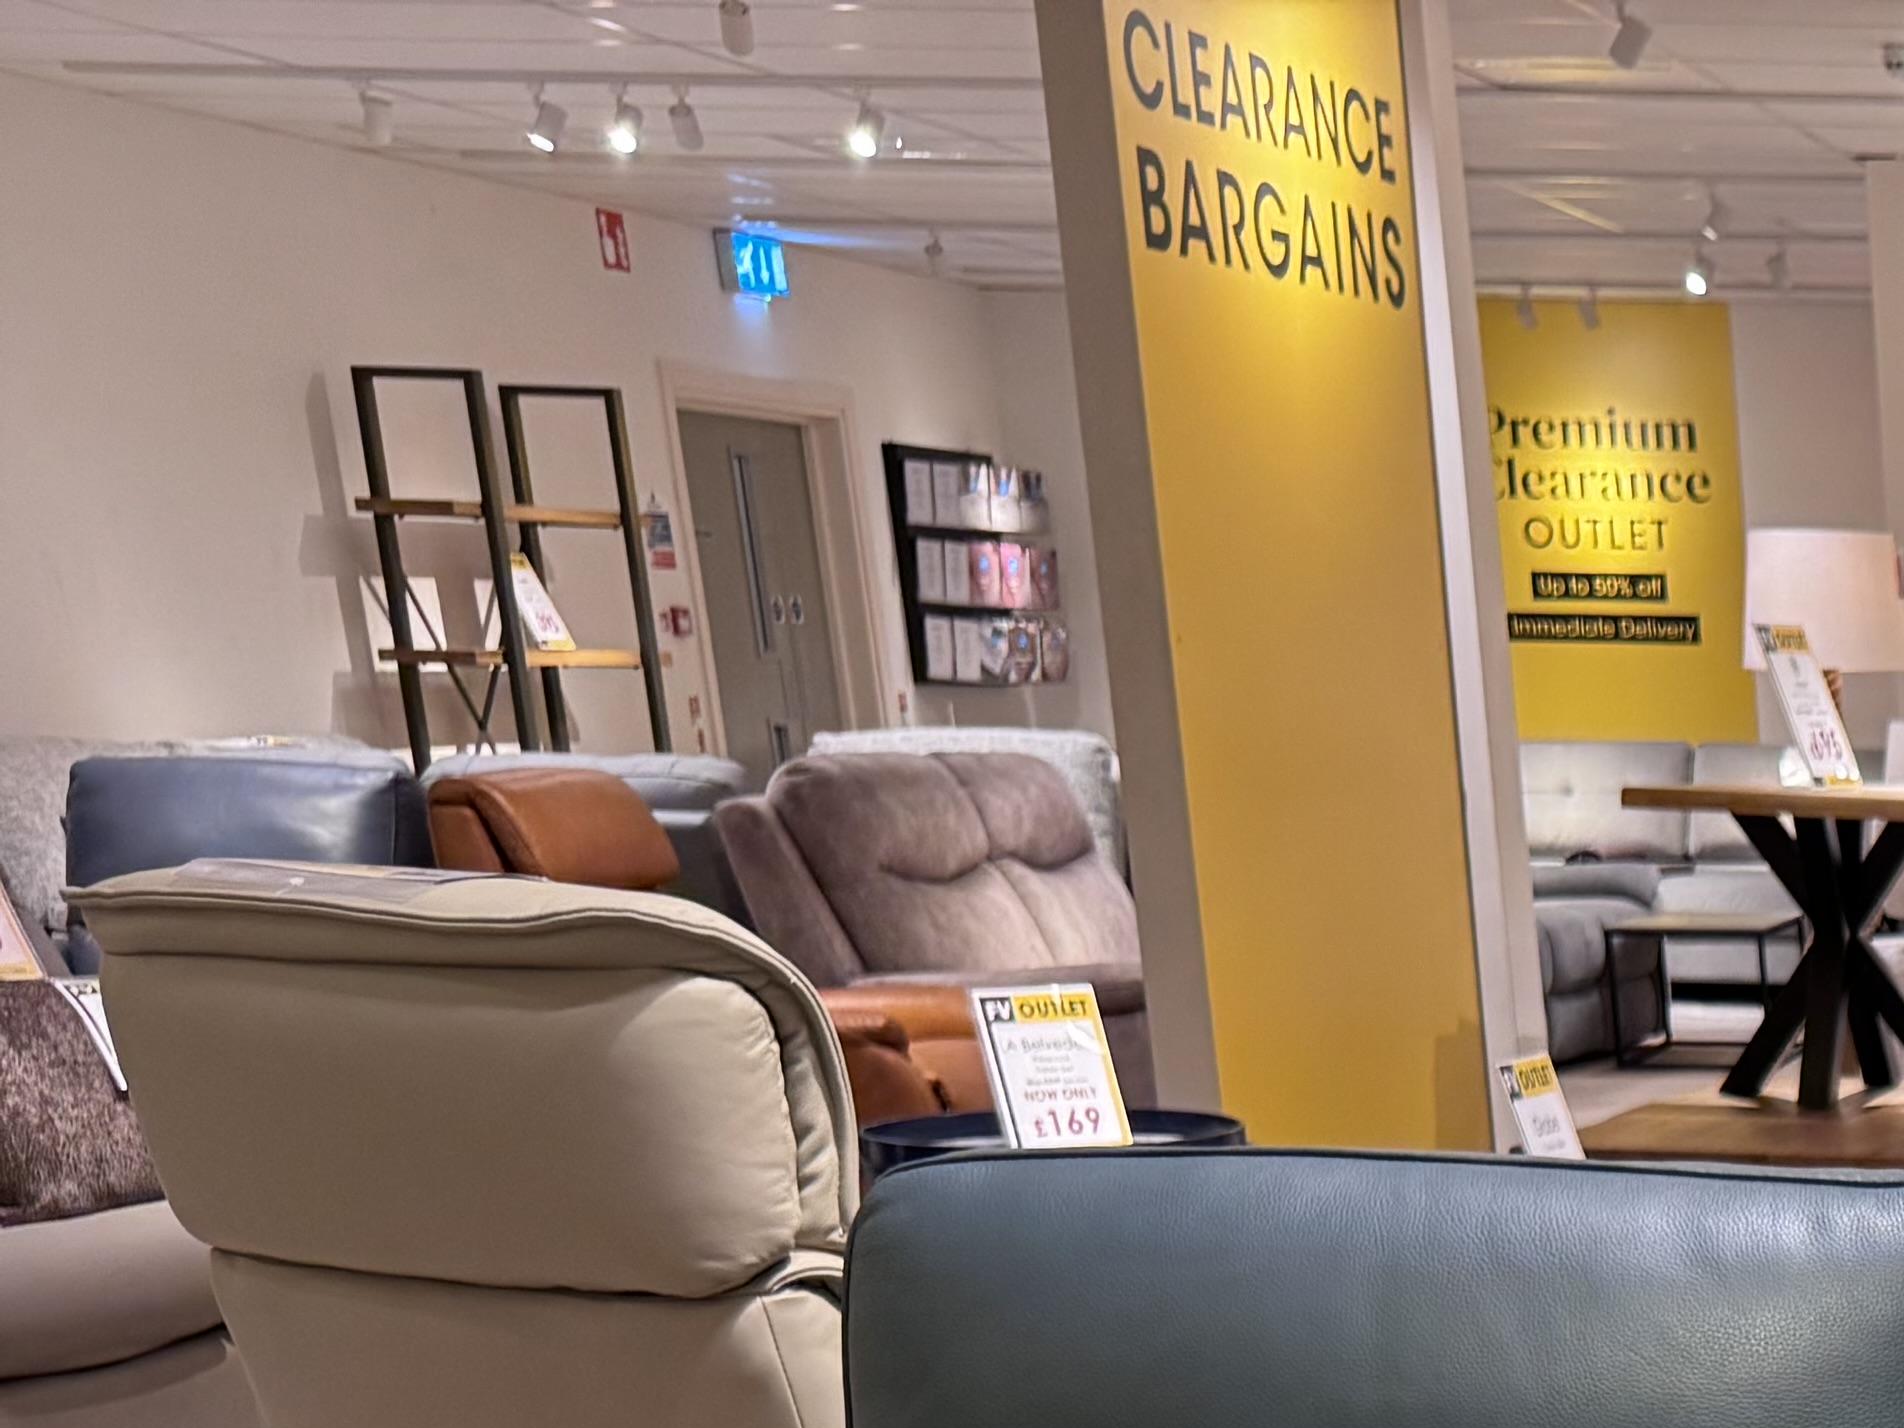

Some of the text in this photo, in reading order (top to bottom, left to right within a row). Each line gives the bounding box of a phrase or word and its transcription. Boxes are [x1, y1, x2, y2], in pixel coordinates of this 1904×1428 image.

[1123, 8, 1397, 186] CLEARANCE
[1136, 144, 1406, 311] BARGAINS
[1493, 457, 1711, 504] learance
[1523, 515, 1668, 551] OUTLET
[1537, 573, 1566, 598] Up
[1569, 575, 1590, 597] to
[1592, 576, 1633, 597] 50%
[1512, 614, 1696, 642] Immediate Delivery
[1019, 1000, 1088, 1019] OUTLET
[1033, 1105, 1101, 1139] £169
